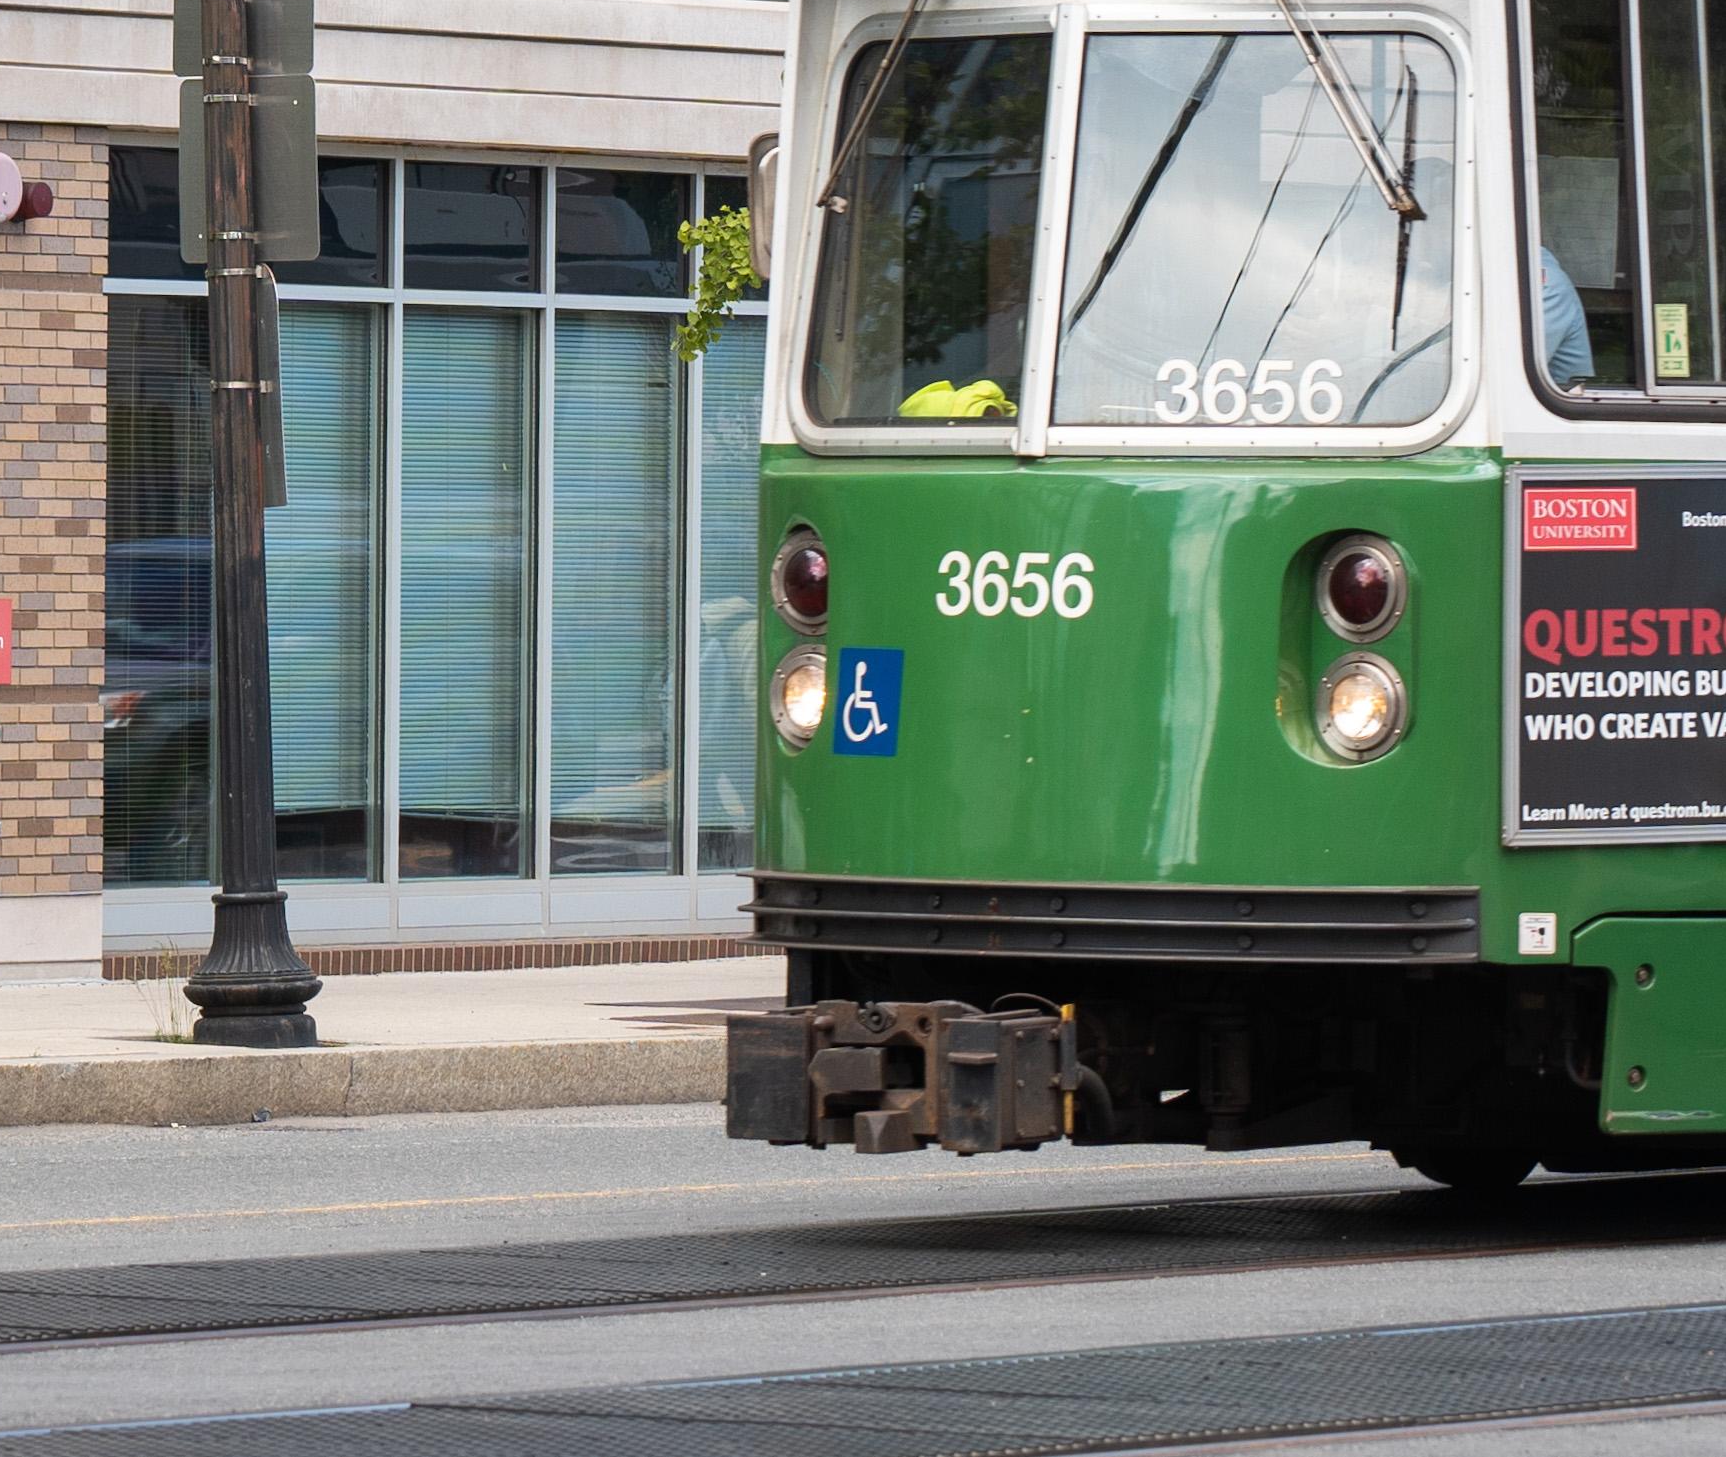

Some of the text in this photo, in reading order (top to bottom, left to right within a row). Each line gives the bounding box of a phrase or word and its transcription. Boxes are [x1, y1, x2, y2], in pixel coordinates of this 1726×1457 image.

[1154, 359, 1343, 425] 3656
[1533, 498, 1627, 518] BOSTON
[1533, 525, 1627, 539] UNIVERSITY
[936, 550, 1095, 619] 3656
[1525, 669, 1690, 699] DEVELOPING
[1525, 713, 1594, 741] WHO
[1599, 712, 1697, 741] CREATE
[1522, 804, 1566, 821] Learn
[1568, 803, 1609, 820] More
[1610, 803, 1628, 820] at
